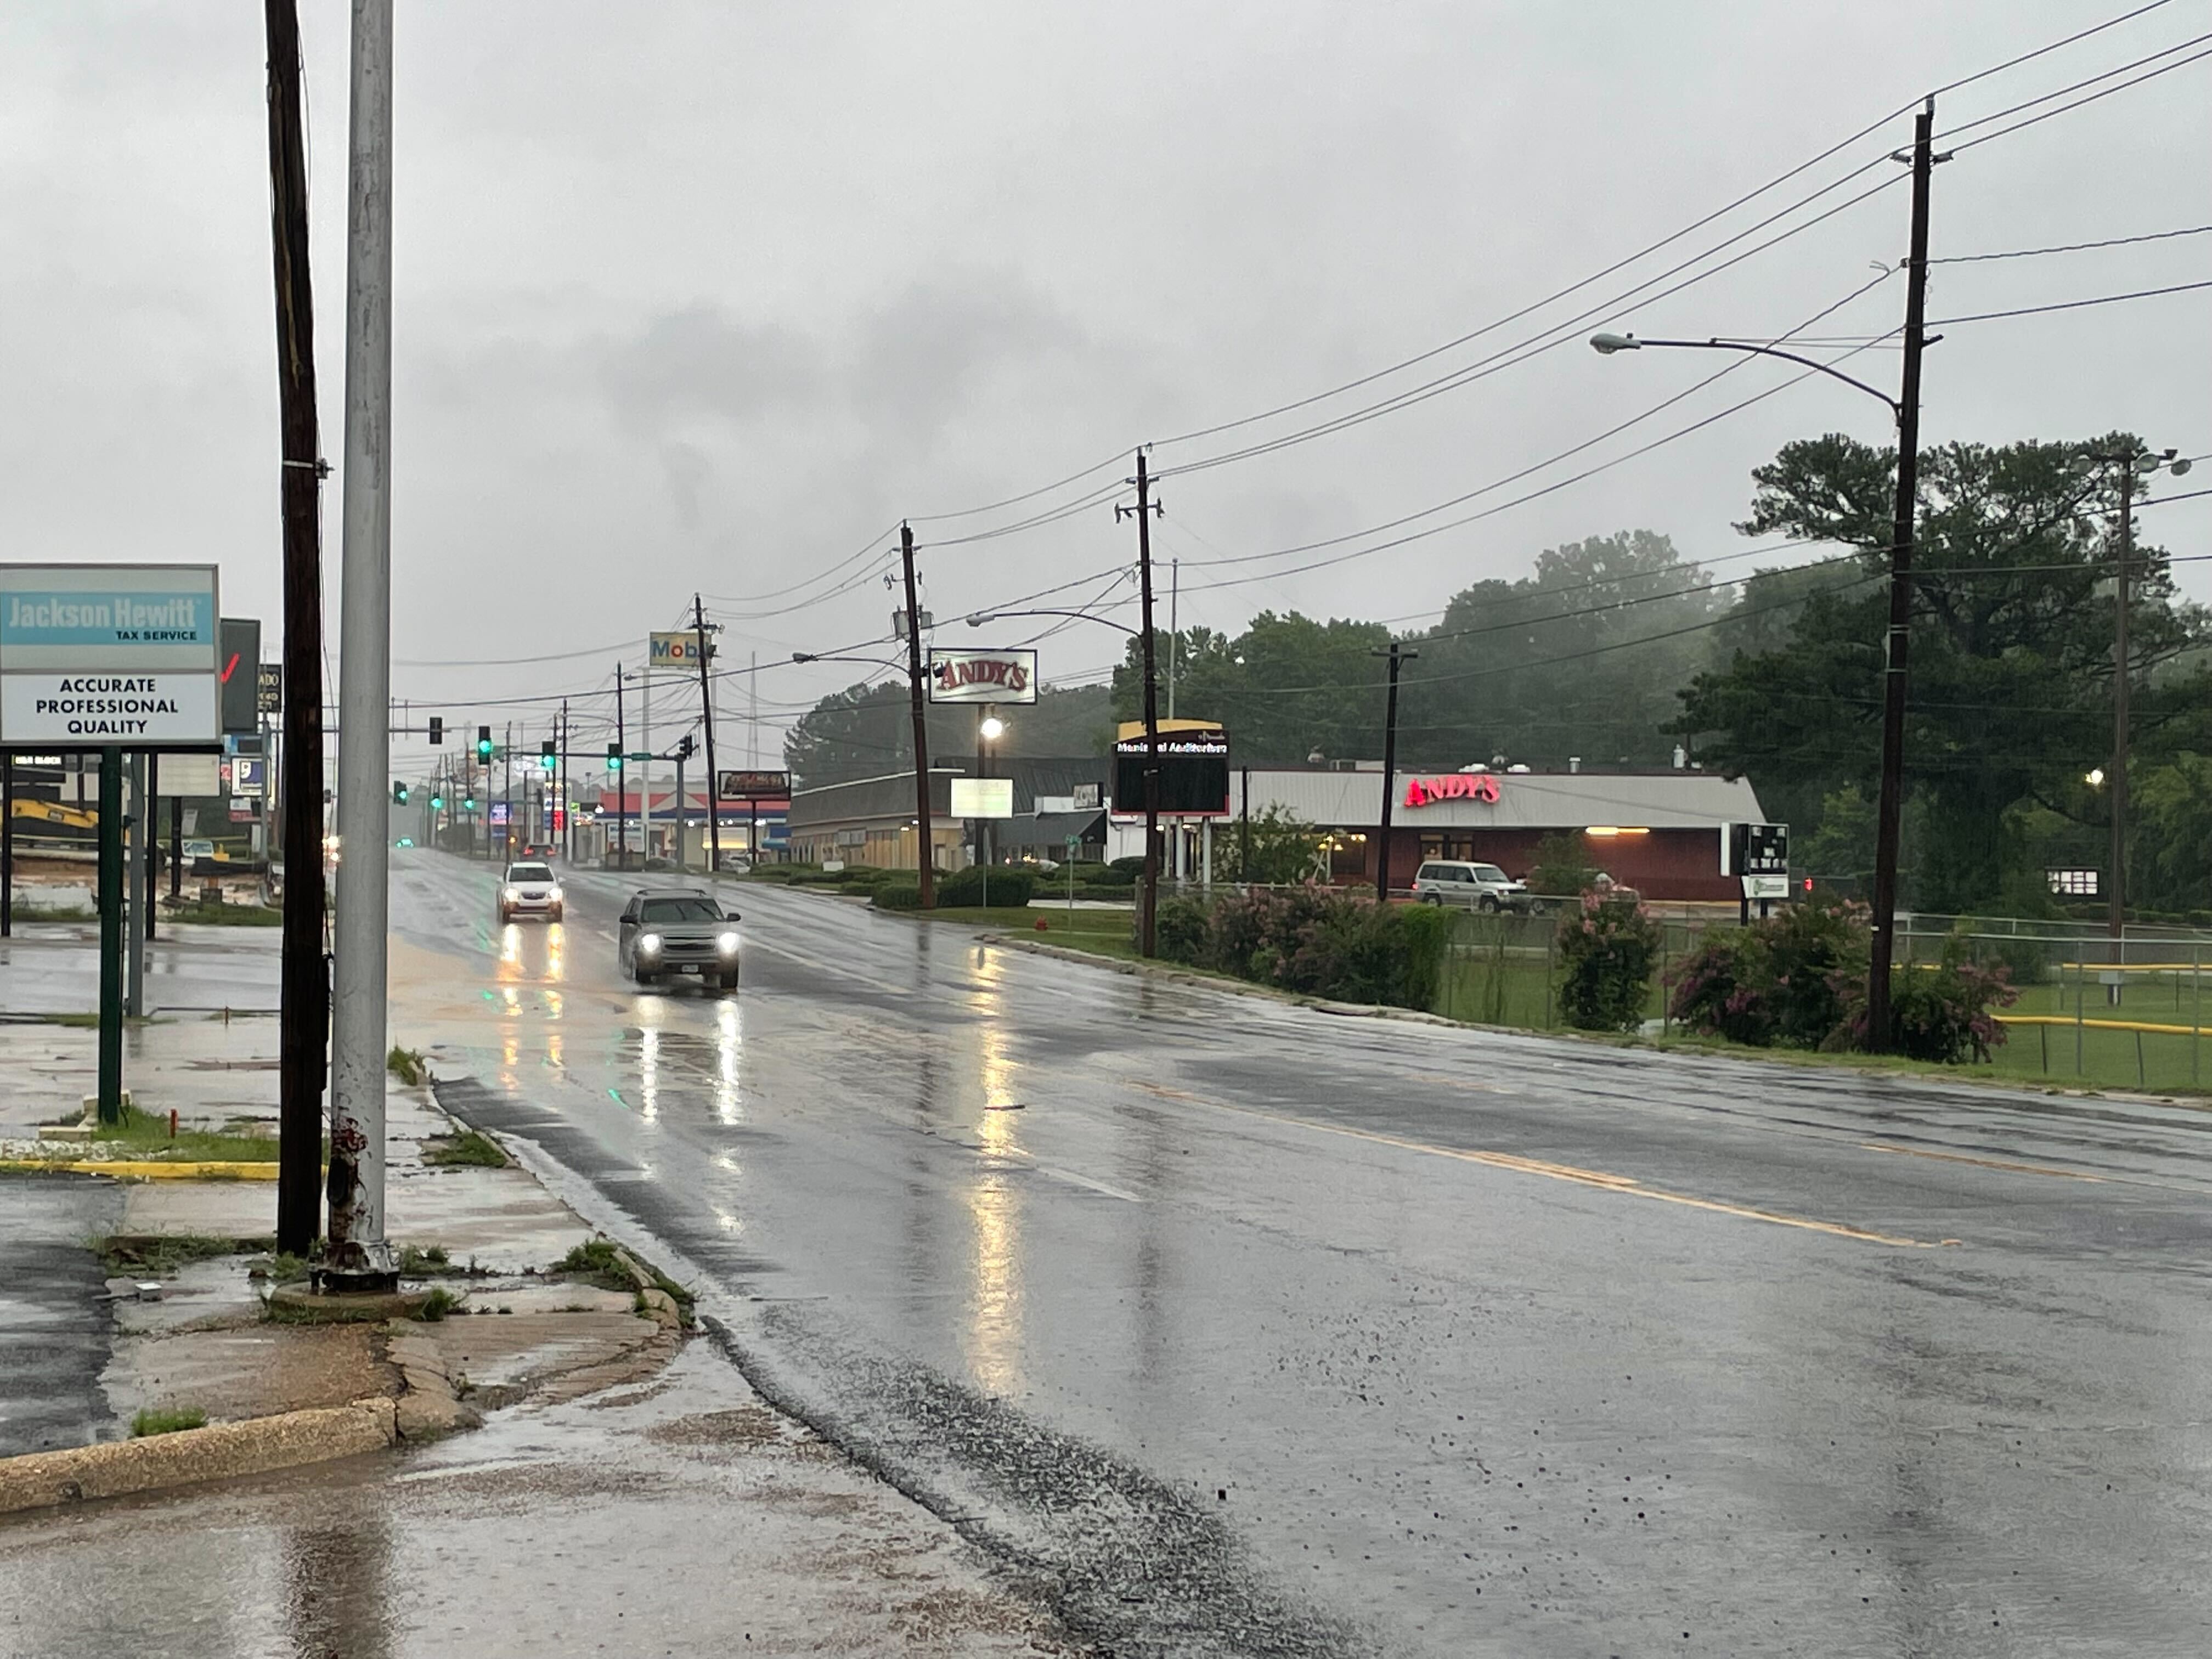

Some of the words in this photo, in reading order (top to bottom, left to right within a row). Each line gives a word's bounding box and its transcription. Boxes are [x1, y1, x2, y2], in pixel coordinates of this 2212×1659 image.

[9, 597, 110, 628] Jackson
[115, 597, 196, 628] Hewitt
[116, 631, 138, 641] TAX
[144, 631, 197, 641] SERVICE
[652, 640, 710, 657] Mob
[936, 659, 1029, 691] ANDY'S
[60, 679, 156, 692] ACCURATE
[36, 699, 178, 713] PROFESSIONAL
[67, 720, 148, 734] QUALITY
[1118, 742, 1167, 753] Munical
[1404, 774, 1503, 807] ANDY'S
